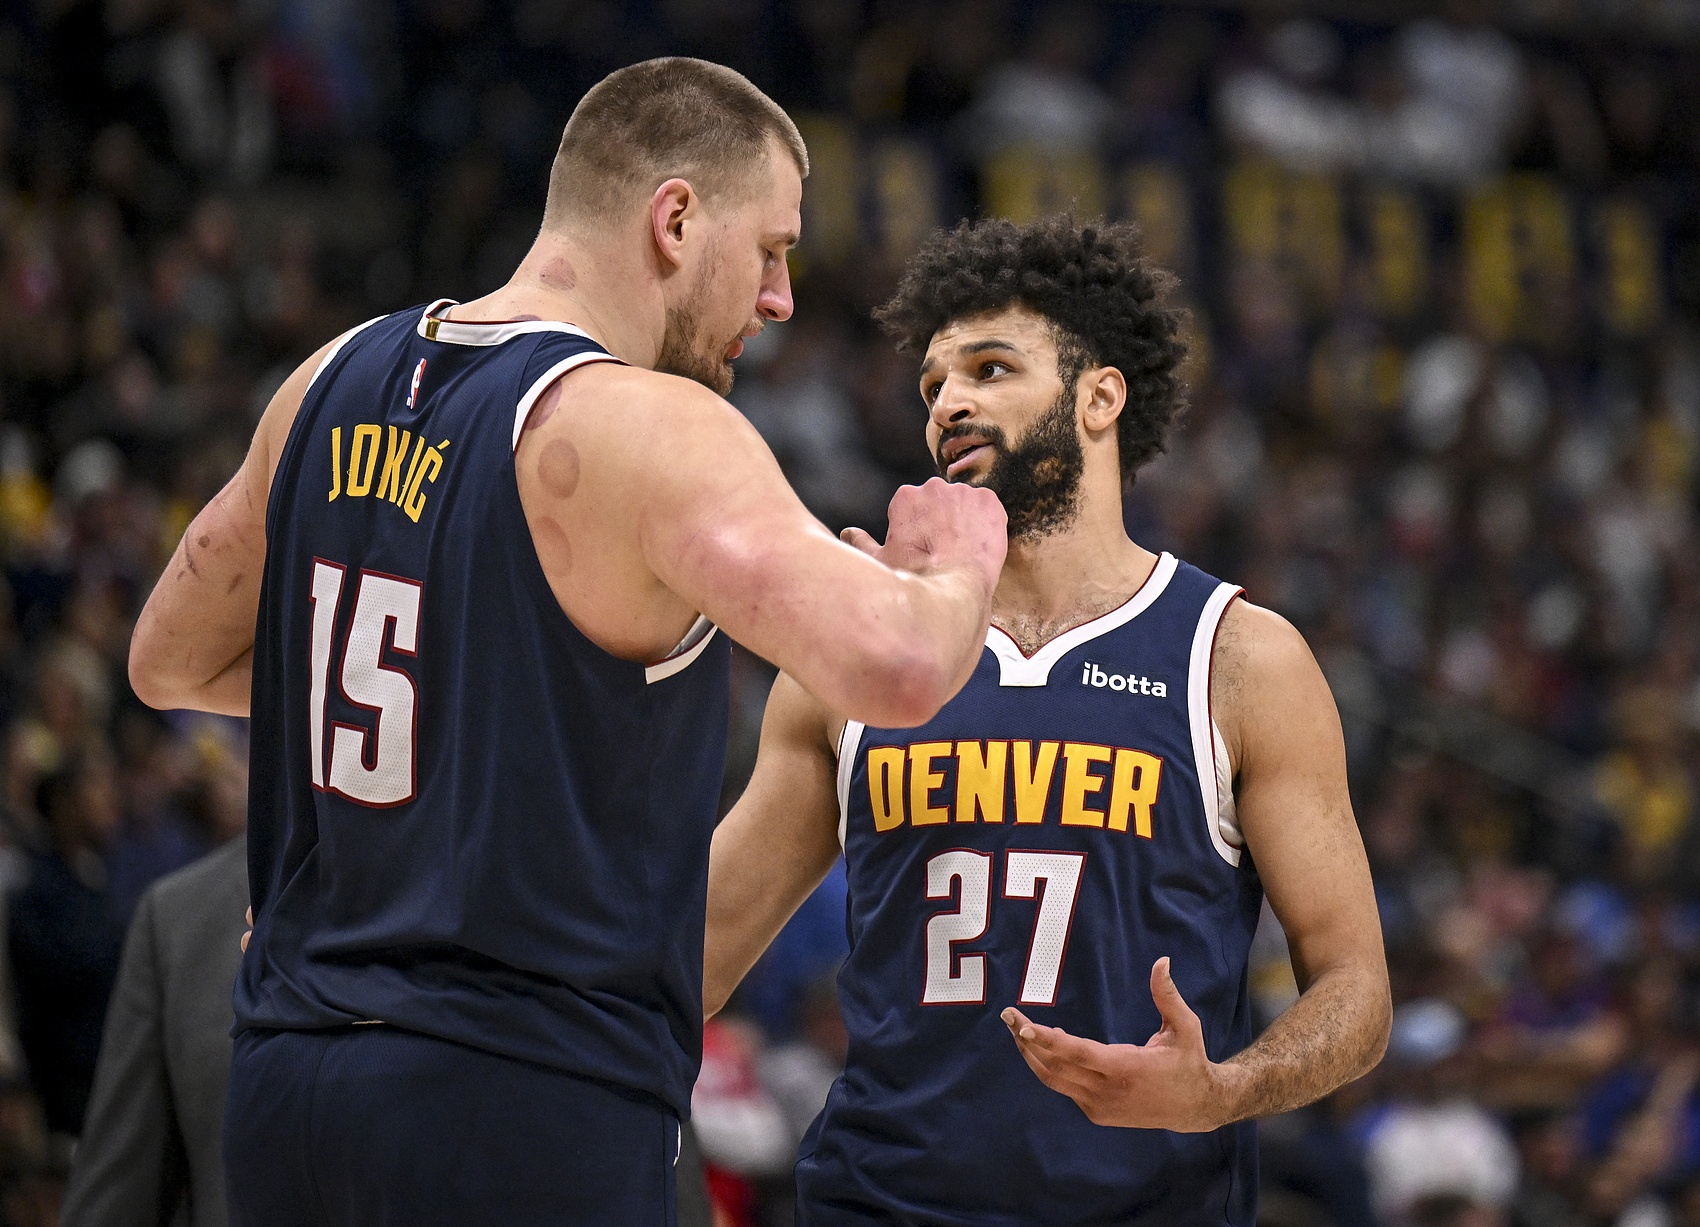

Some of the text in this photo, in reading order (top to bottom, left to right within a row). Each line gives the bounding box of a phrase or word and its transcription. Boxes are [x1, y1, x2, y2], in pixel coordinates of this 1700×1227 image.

[329, 424, 450, 523] JOKIĆ
[310, 556, 423, 808] 15
[1082, 662, 1167, 698] ibotta
[867, 739, 1163, 839] DENVER
[919, 847, 1088, 1007] 27
